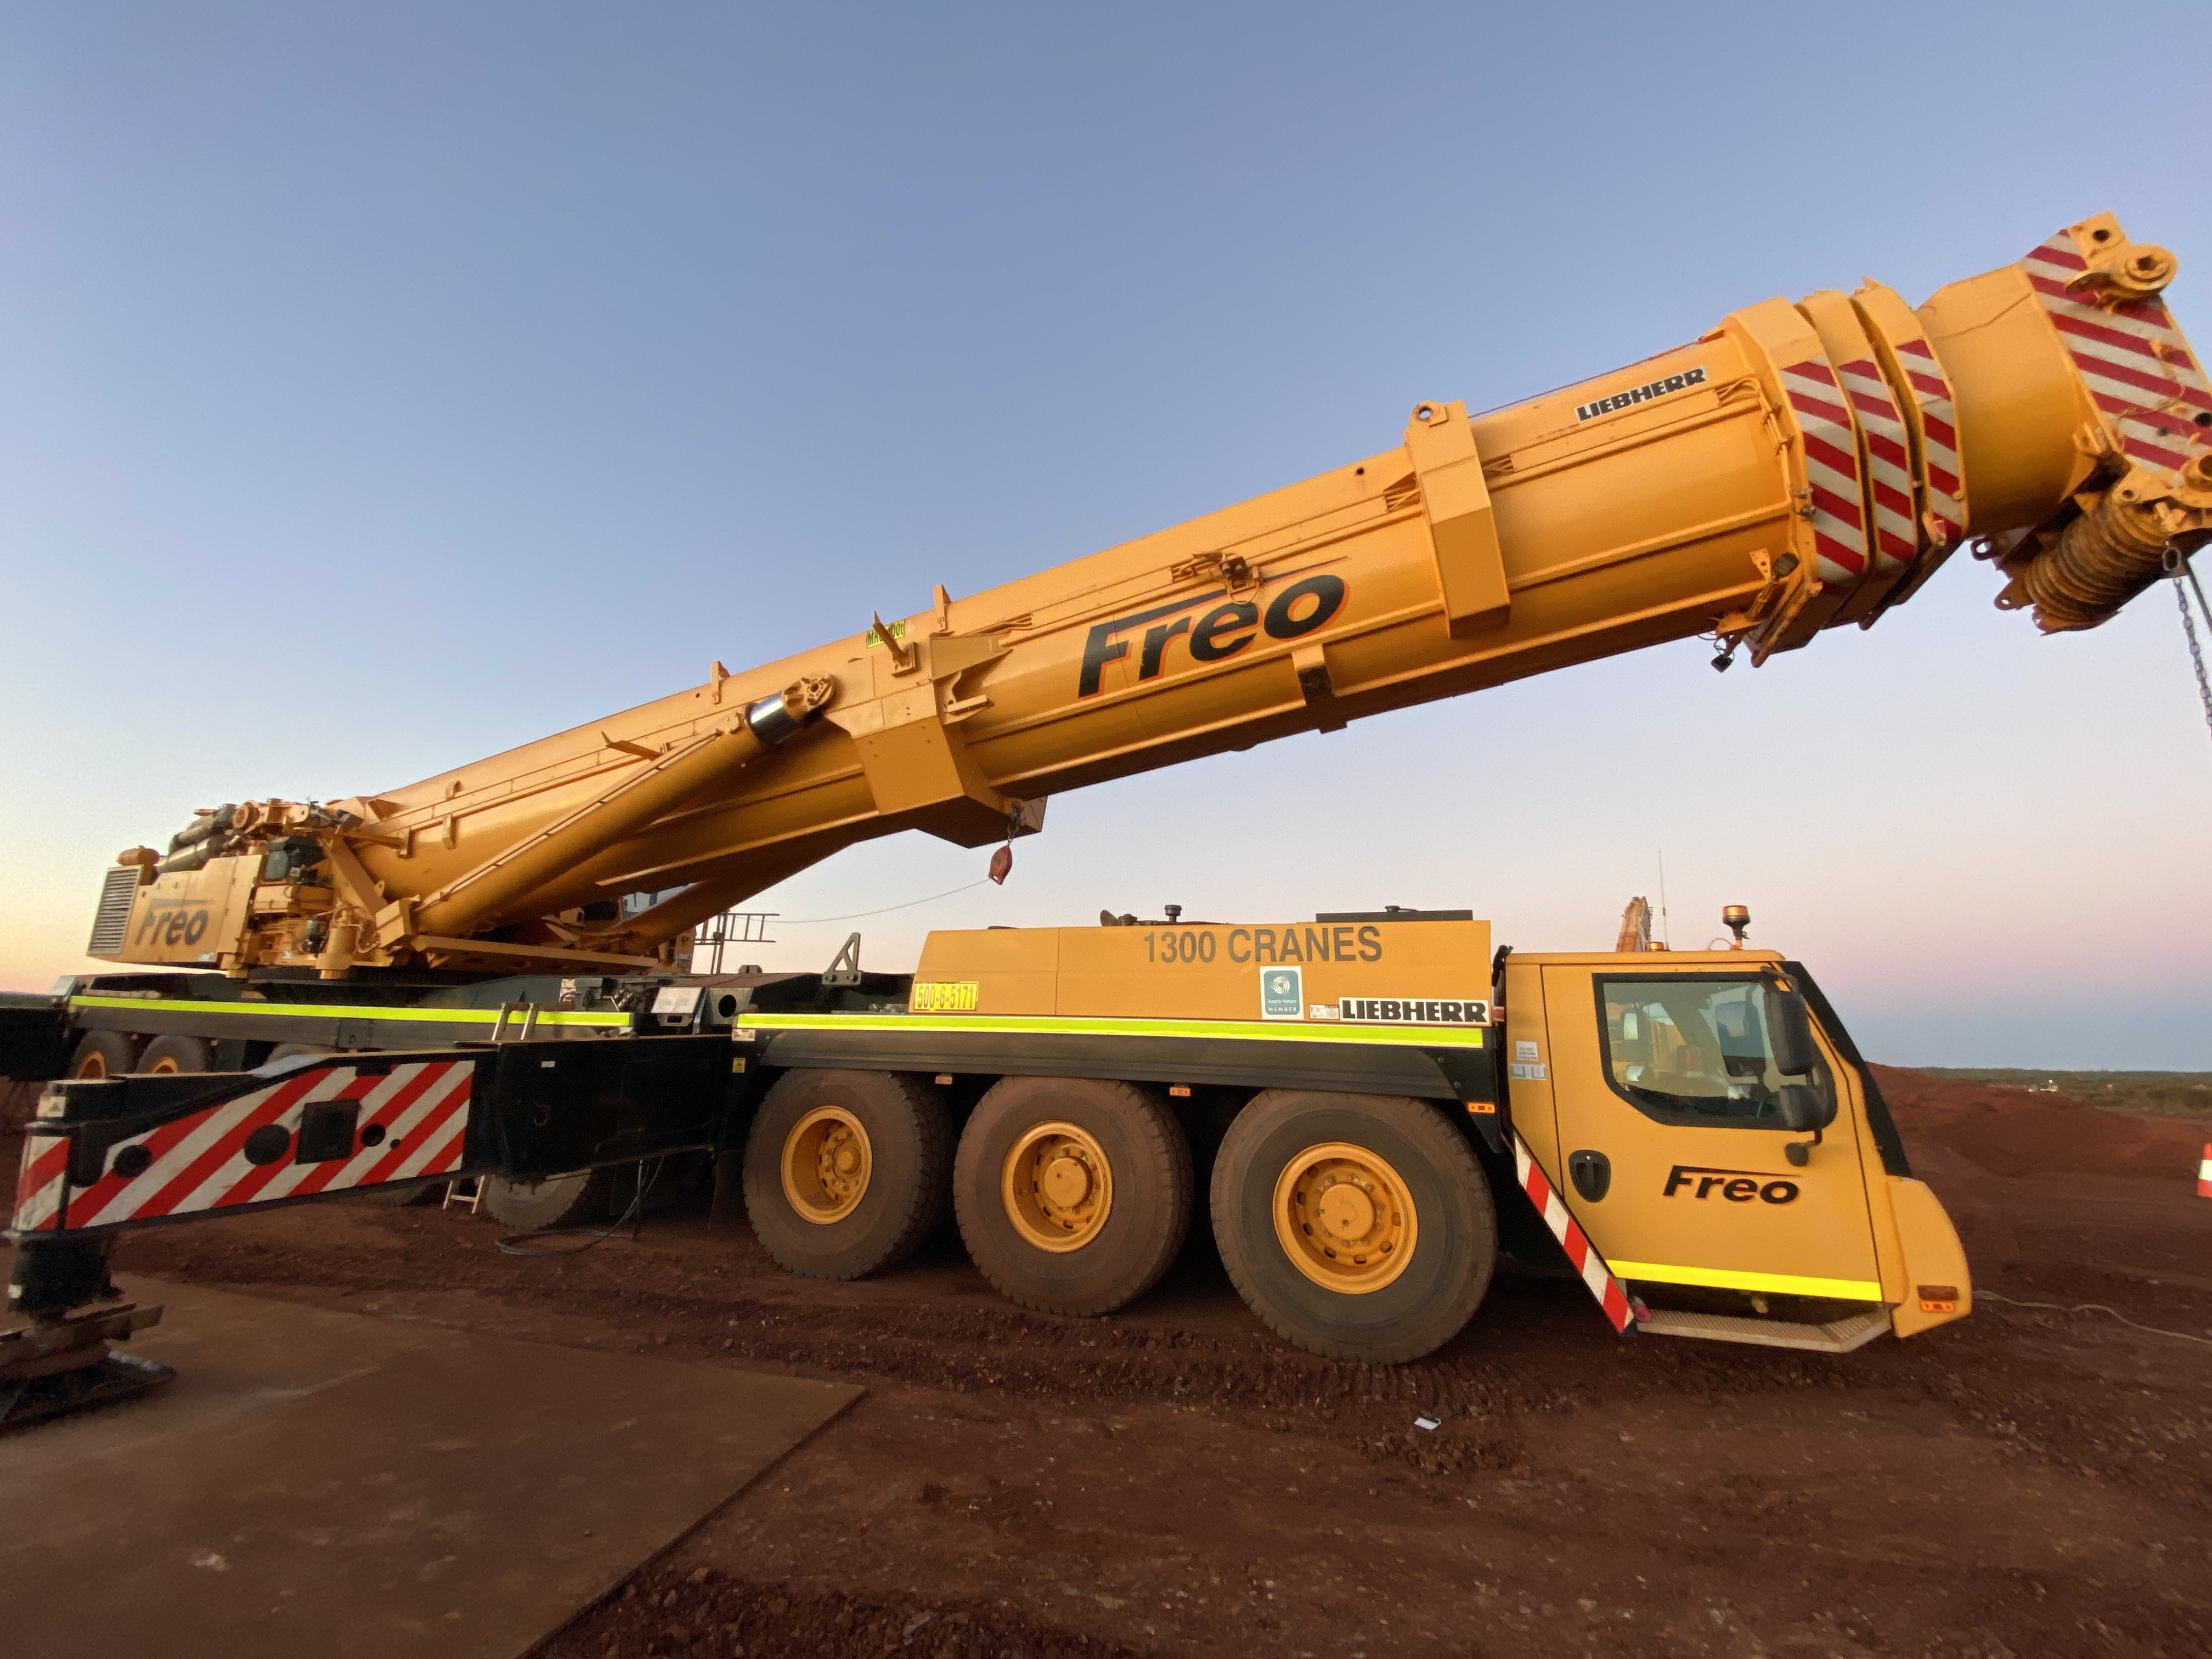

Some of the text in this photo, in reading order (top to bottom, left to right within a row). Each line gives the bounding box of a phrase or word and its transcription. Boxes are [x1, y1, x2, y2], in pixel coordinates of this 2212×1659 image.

[1576, 368, 1706, 421] LIEBHERR
[1077, 560, 1350, 699] Freo
[134, 898, 213, 946] Freo
[1143, 926, 1383, 963] 1300 CRANES
[917, 985, 973, 1008] 500-6-5171
[1342, 1000, 1487, 1023] LIEBHERR
[1662, 1164, 1802, 1205] Freo
